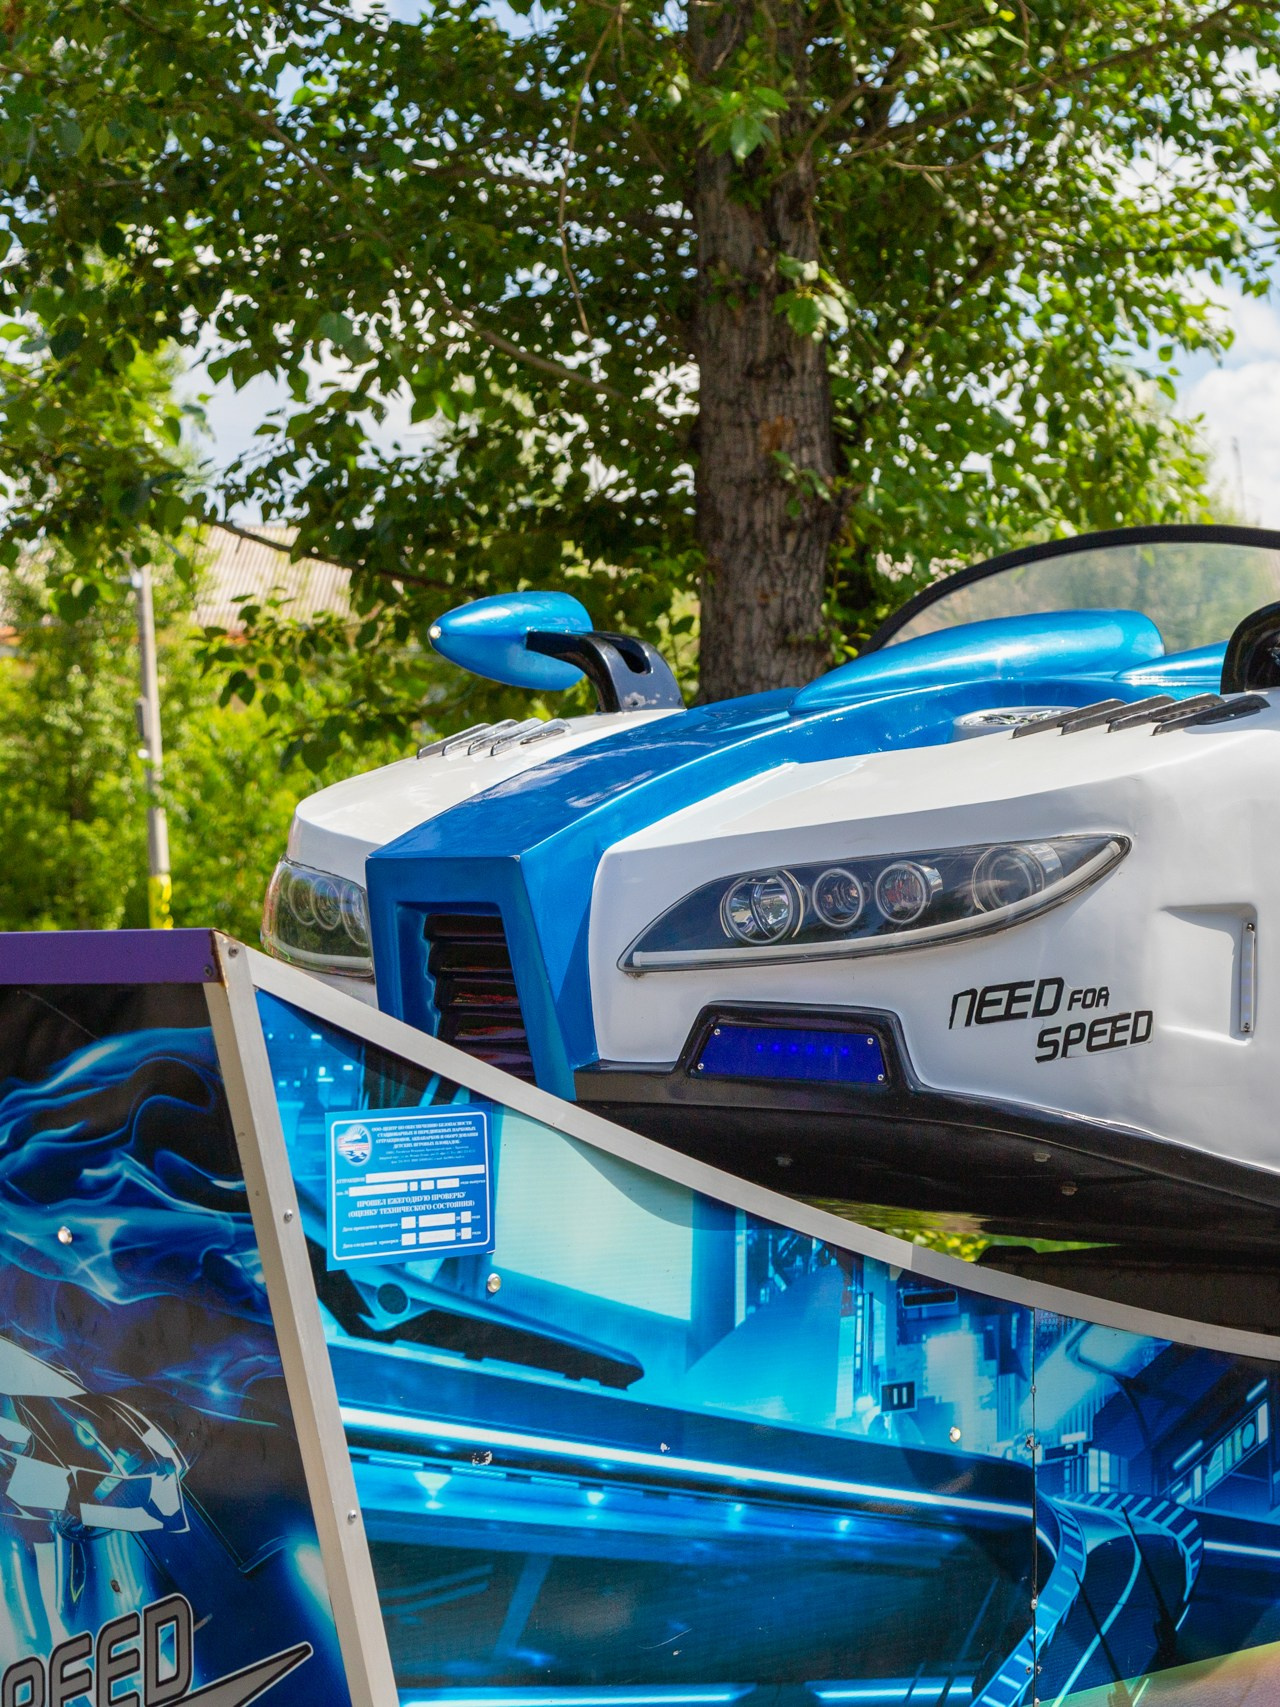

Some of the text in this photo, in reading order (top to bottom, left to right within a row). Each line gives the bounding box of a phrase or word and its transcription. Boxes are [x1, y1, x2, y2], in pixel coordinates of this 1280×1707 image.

[948, 976, 1110, 1030] NEED FOR
[1034, 1010, 1154, 1063] SPEED
[379, 1204, 432, 1214] ТЕХНИЧЕСКОГО
[387, 1195, 430, 1205] ЕЖЕГОДНУЮ
[431, 1192, 466, 1201] ПРОВЕРКУ
